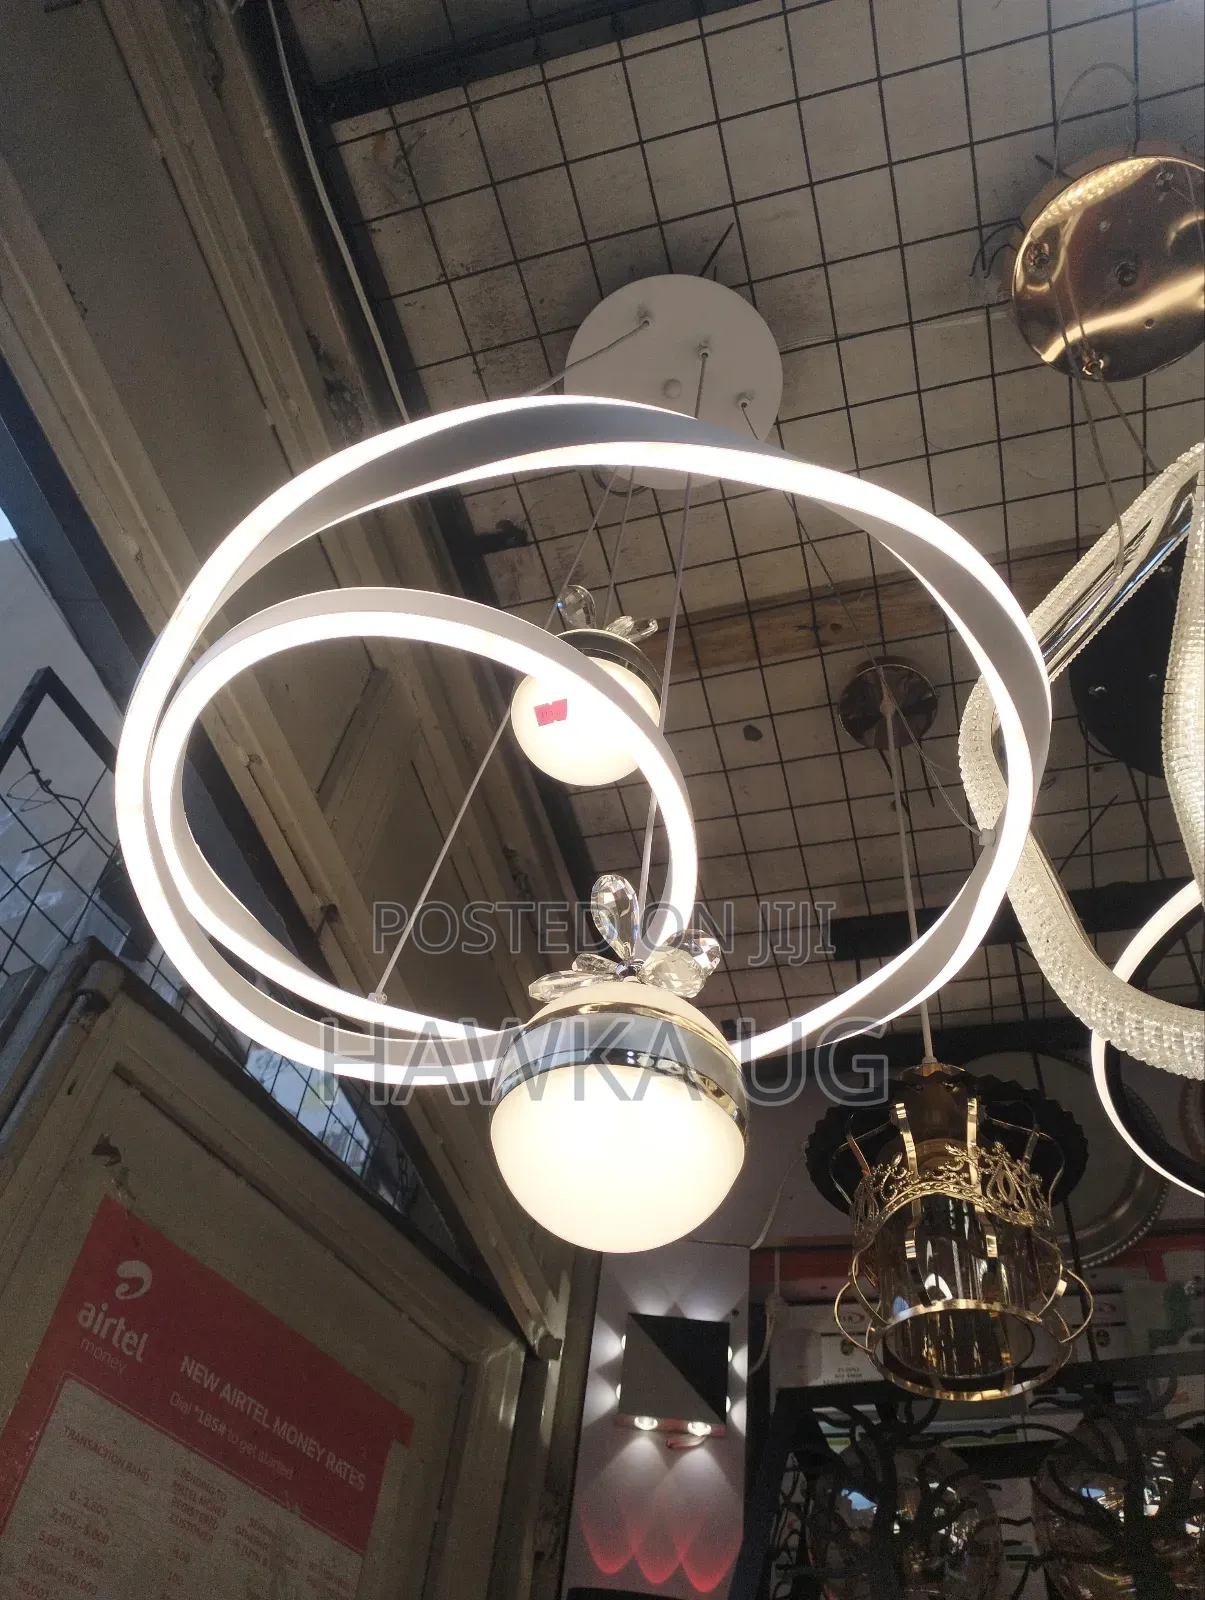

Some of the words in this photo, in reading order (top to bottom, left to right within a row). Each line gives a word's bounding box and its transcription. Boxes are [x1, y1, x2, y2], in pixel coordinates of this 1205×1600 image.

[77, 1301, 149, 1364] airtel
[80, 1338, 128, 1375] money
[63, 1425, 125, 1468] TRANSACTION
[169, 1391, 192, 1415] Dial
[228, 1425, 239, 1443] to
[239, 1436, 258, 1459] get
[258, 1444, 294, 1480] started
[180, 1355, 220, 1392] NEW
[220, 1382, 270, 1428] AIRTEL
[273, 1416, 327, 1463] MONEY
[326, 1448, 366, 1492] RATES
